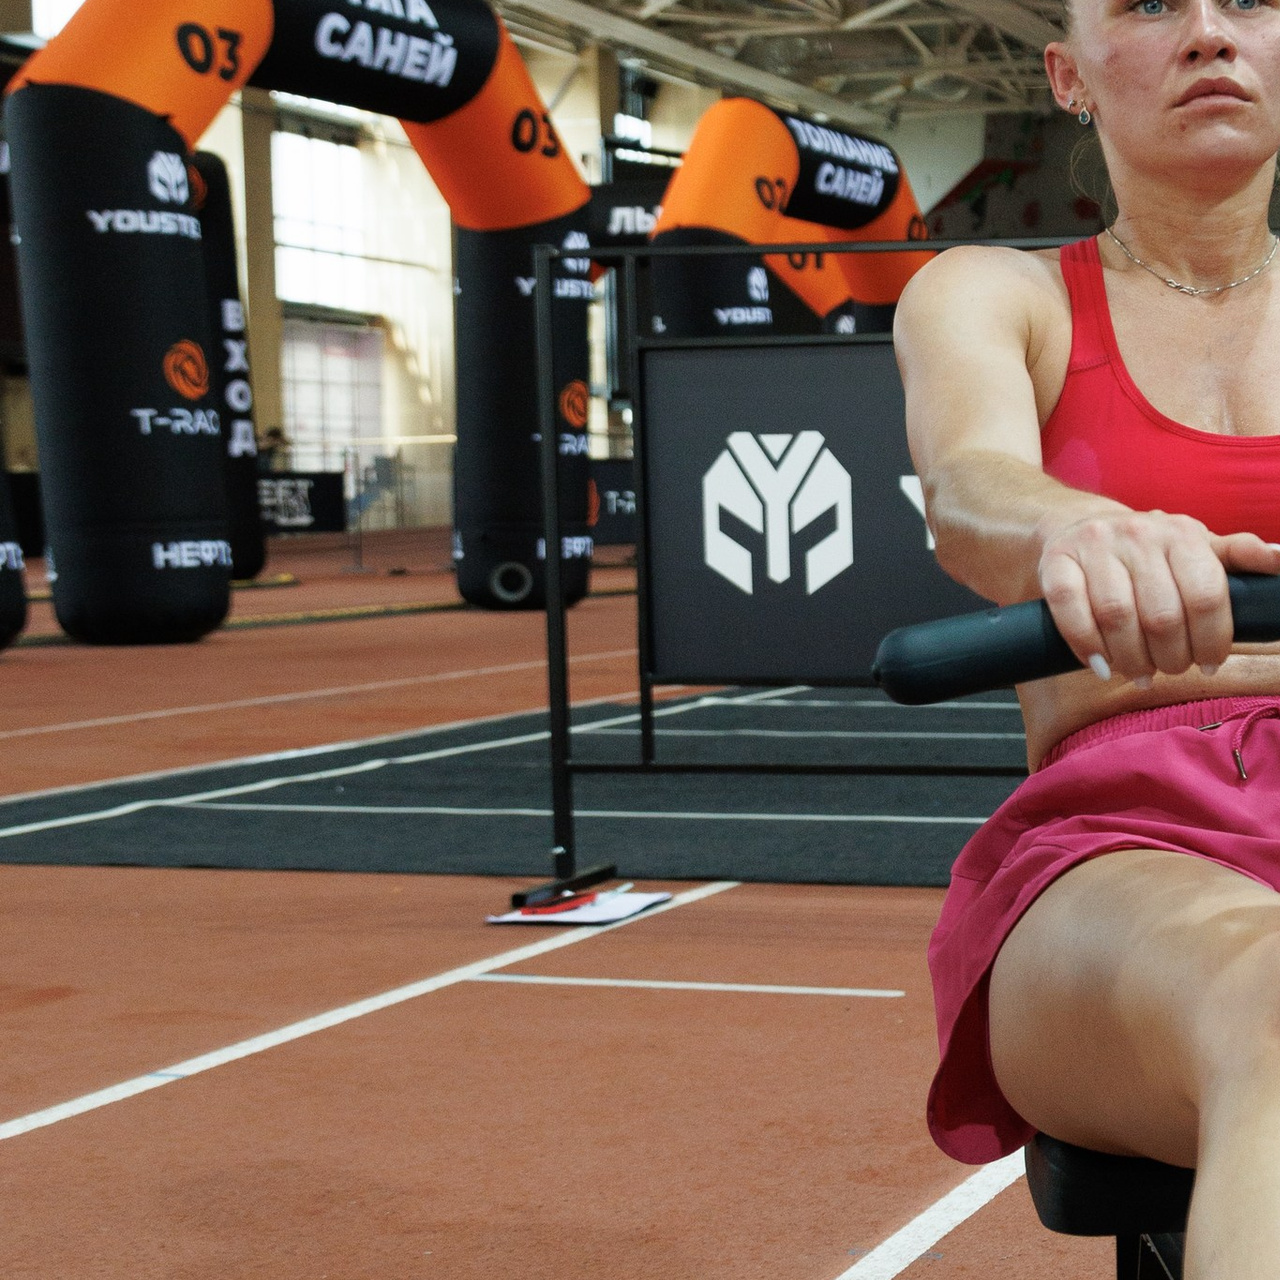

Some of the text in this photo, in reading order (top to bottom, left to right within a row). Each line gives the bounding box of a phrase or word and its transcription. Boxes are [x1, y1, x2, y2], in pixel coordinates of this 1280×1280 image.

[176, 23, 241, 81] 03
[315, 13, 459, 89] САНЕЙ
[511, 108, 560, 158] 03
[814, 161, 885, 207] САНЕЙ
[220, 299, 258, 458] ВХОД
